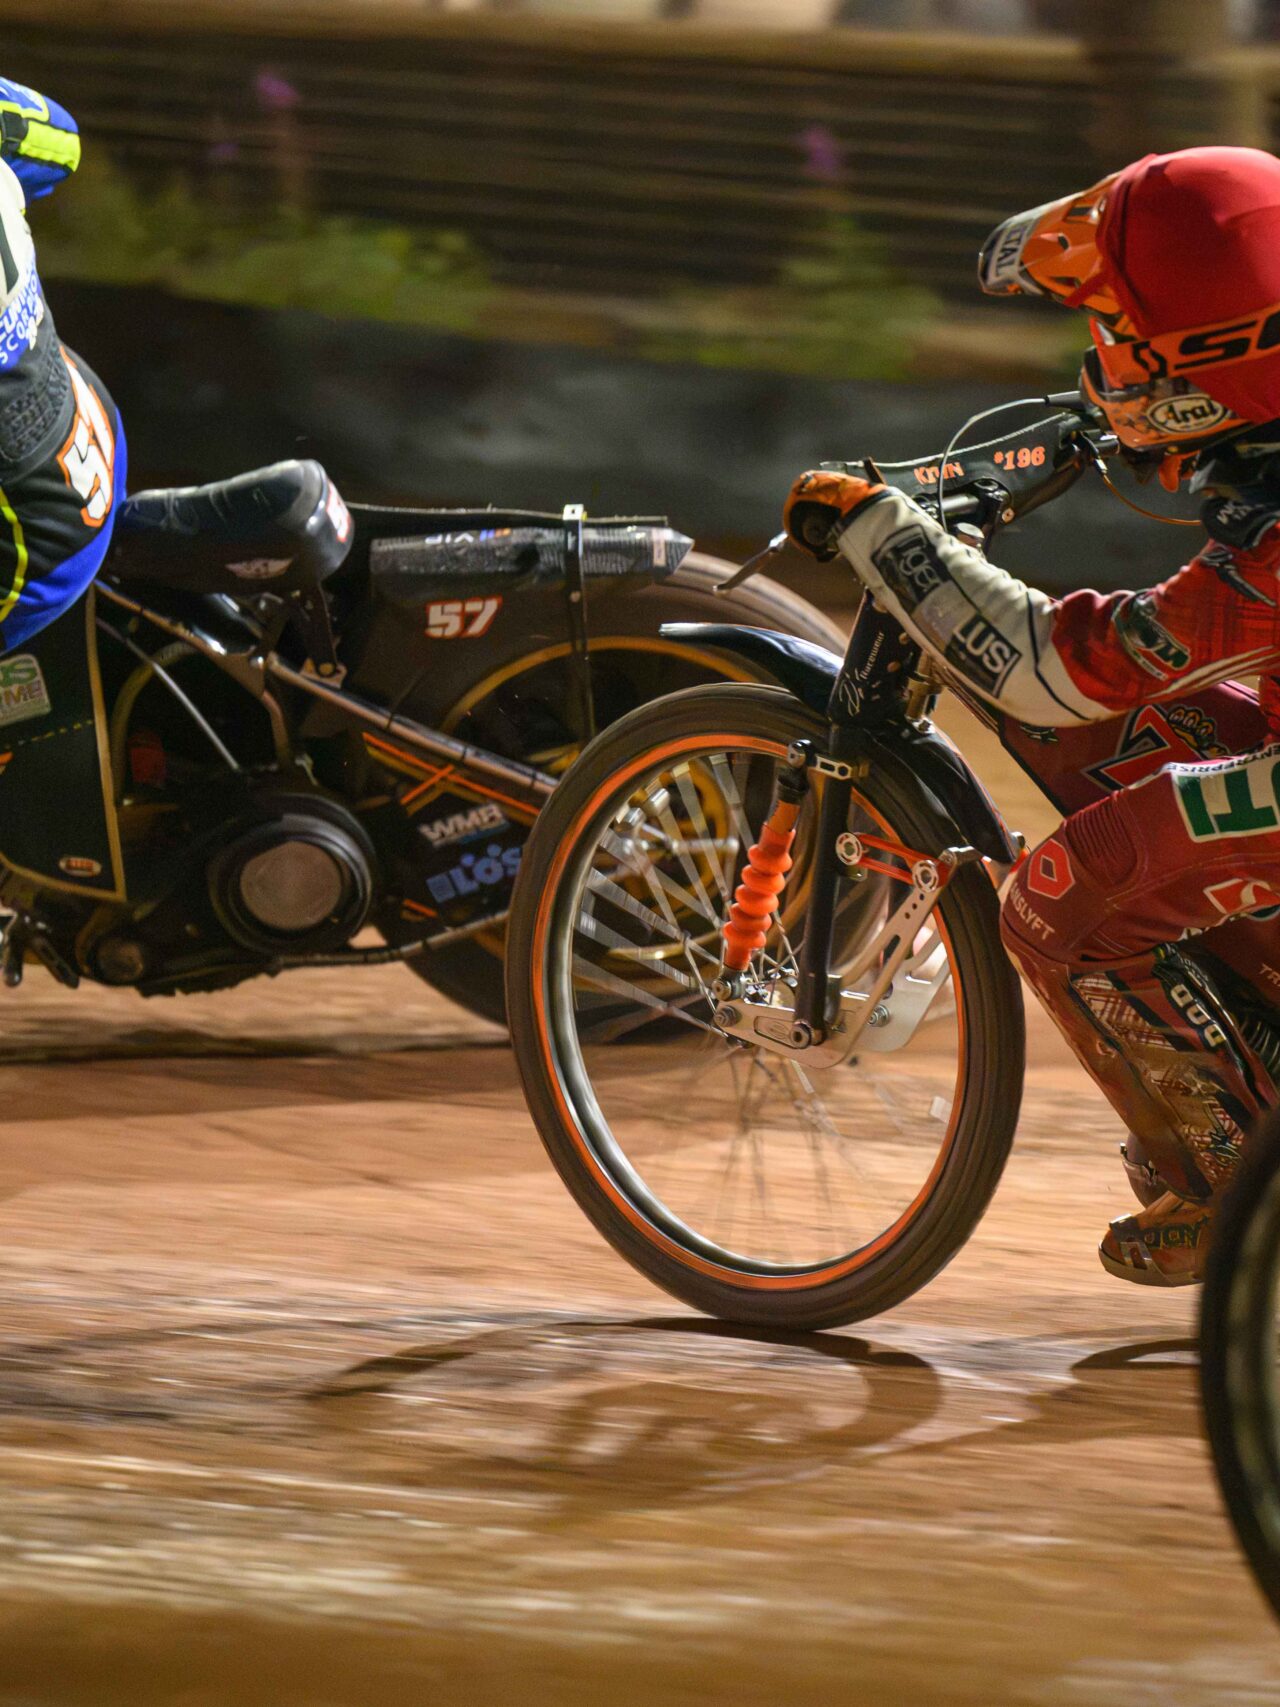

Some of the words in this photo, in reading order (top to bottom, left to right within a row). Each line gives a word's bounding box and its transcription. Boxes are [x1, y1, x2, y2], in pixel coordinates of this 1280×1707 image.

[1161, 397, 1219, 425] Arai
[993, 446, 1046, 471] #196
[424, 596, 502, 640] 57
